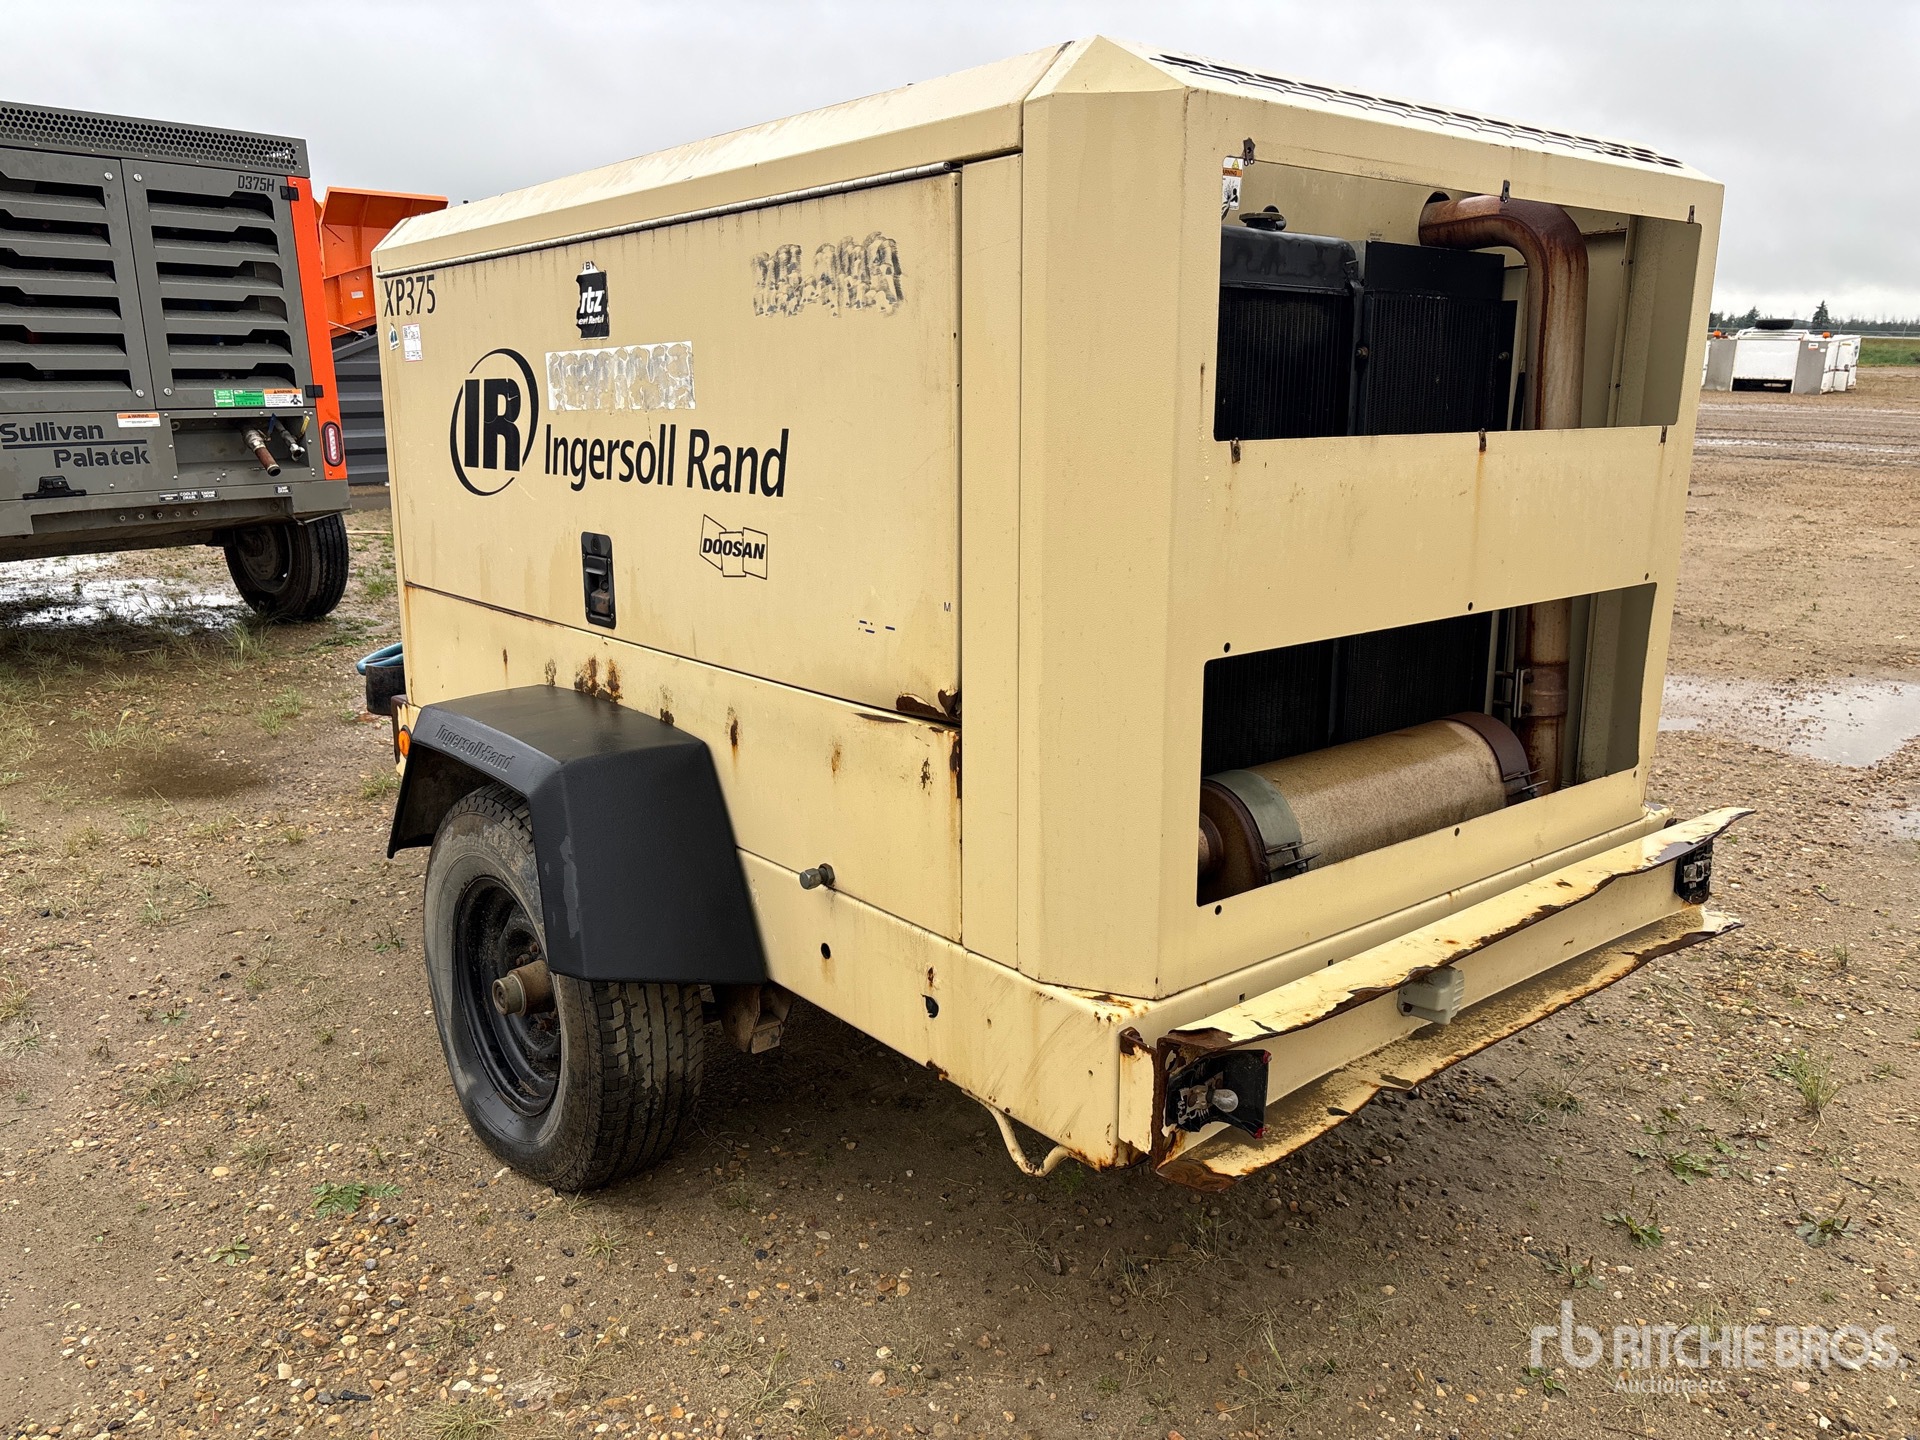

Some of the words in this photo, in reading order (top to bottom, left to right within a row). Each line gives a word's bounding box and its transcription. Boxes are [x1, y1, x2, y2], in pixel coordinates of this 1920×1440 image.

[237, 174, 275, 192] D375H
[383, 274, 436, 318] XP375
[0, 421, 104, 443] Sullivan
[464, 377, 521, 473] IR
[53, 446, 151, 469] Palatek
[544, 423, 678, 493] Ingersoll
[686, 427, 790, 499] Rand
[702, 537, 766, 560] DOOSAN
[435, 724, 485, 758] Ingersoll
[480, 746, 516, 772] Rand
